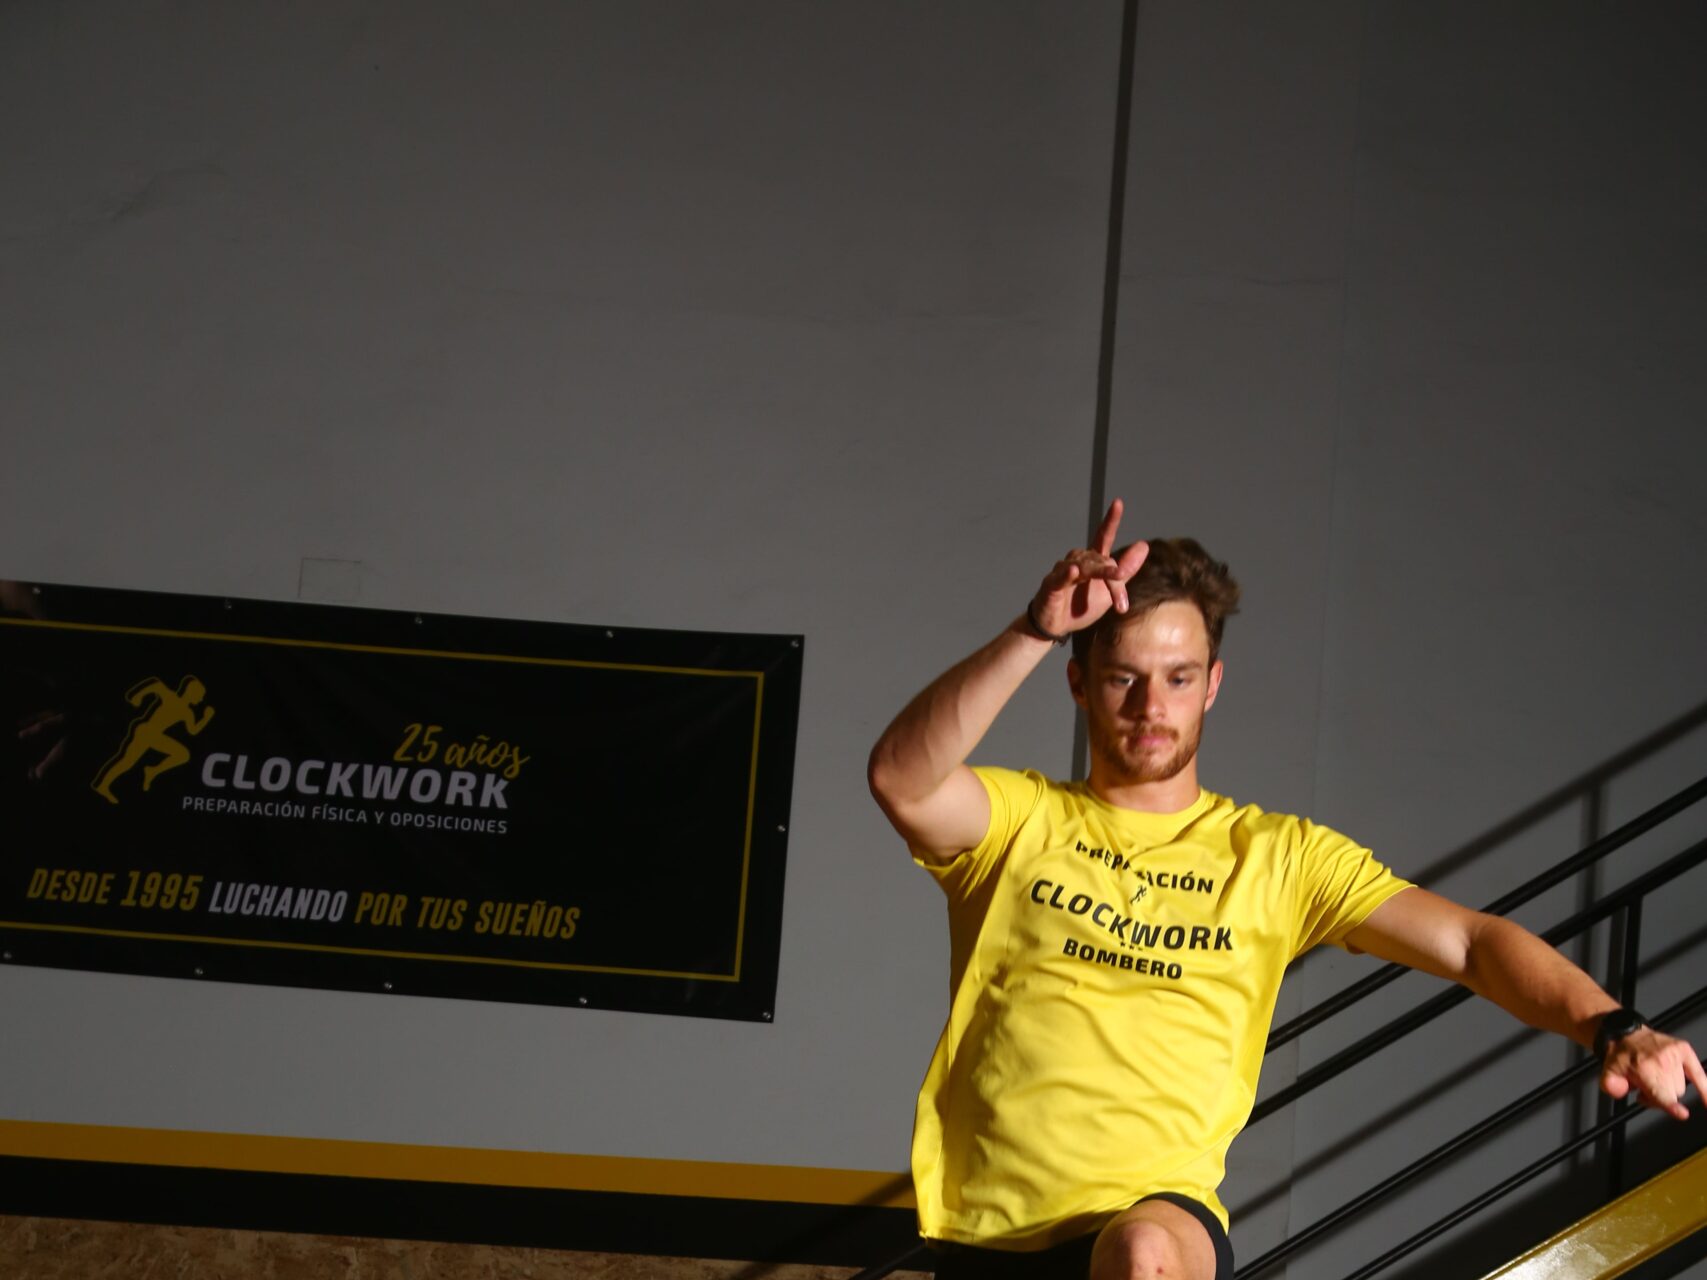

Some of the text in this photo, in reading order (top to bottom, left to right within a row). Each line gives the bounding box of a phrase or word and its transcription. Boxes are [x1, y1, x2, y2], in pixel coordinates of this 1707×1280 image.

[393, 721, 532, 780] 25 años
[201, 752, 510, 809] CLOCKWORK
[182, 796, 508, 835] PREPARACIÓN FÍSICA Y OPOSICIONES
[26, 867, 581, 940] DESDE 1995 LUCHANDO POR TUS SUEÑOS
[1030, 879, 1233, 951] CLOCKWORK
[1062, 938, 1183, 980] BOMBERO
